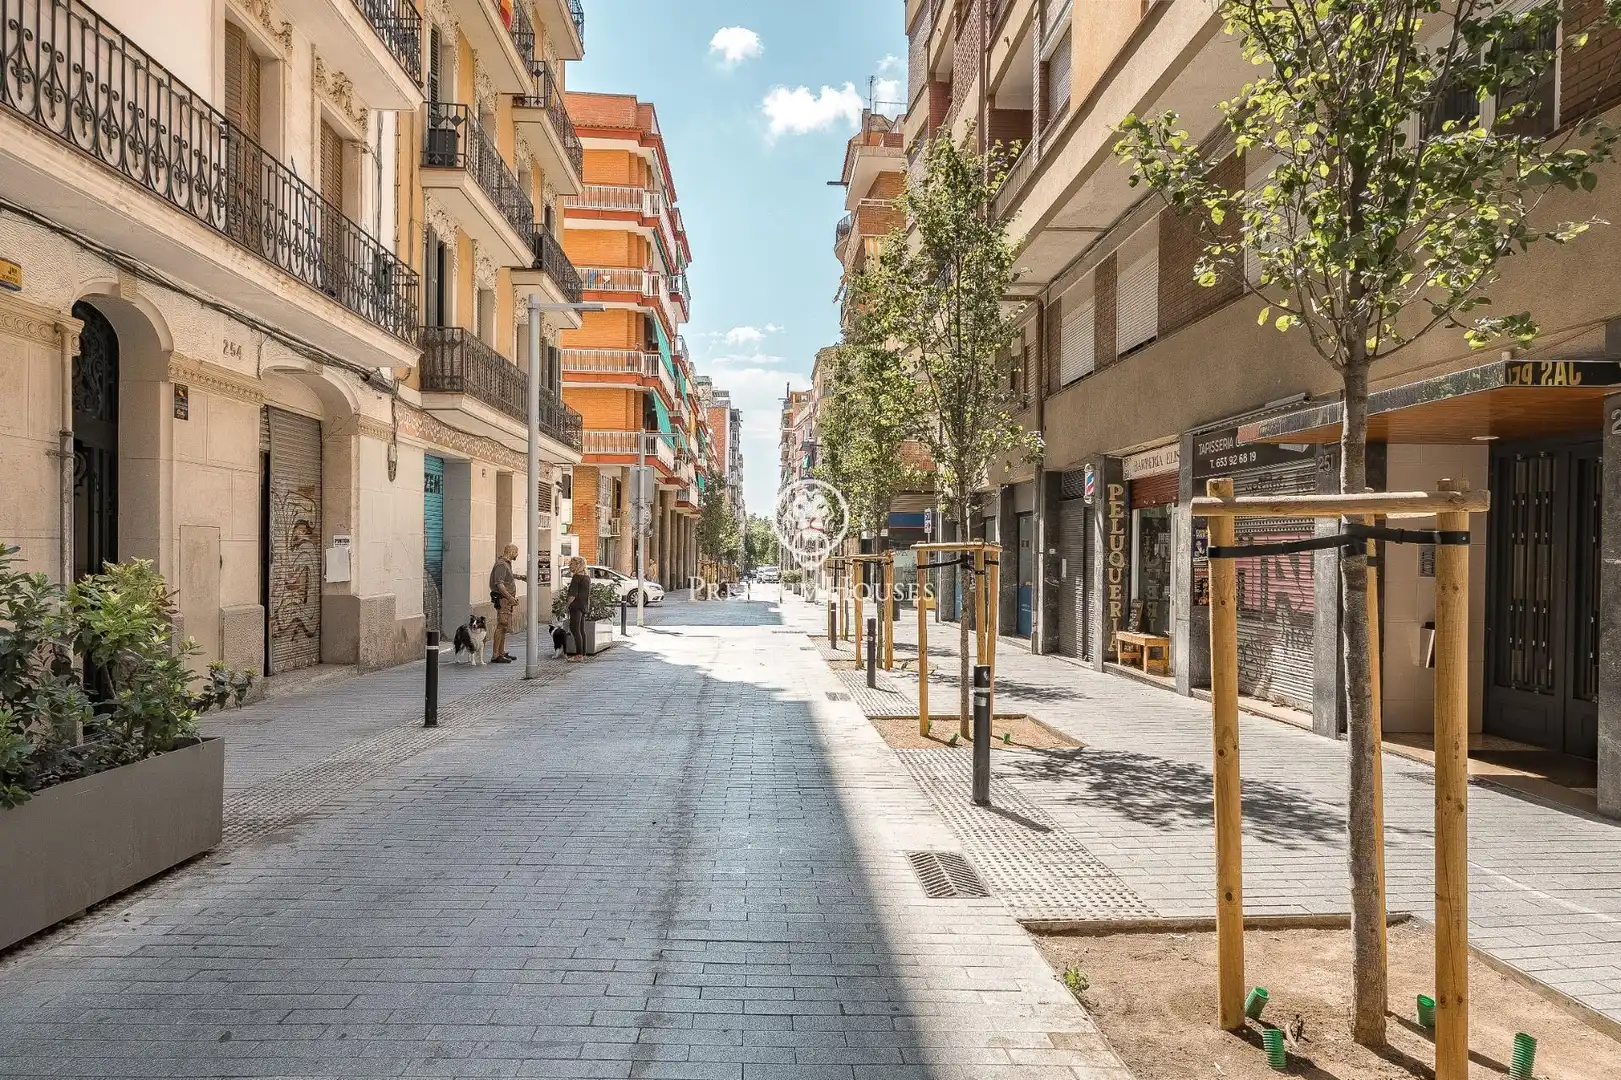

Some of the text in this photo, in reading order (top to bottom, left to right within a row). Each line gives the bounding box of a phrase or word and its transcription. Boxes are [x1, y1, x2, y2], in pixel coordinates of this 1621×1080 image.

[222, 339, 242, 361] 254
[1198, 436, 1235, 456] TAPISSERIA
[1216, 456, 1228, 468] 653
[1229, 454, 1238, 466] 92
[1239, 452, 1248, 464] 68
[1250, 451, 1257, 462] 19
[1107, 484, 1125, 652] PELUQUERIA
